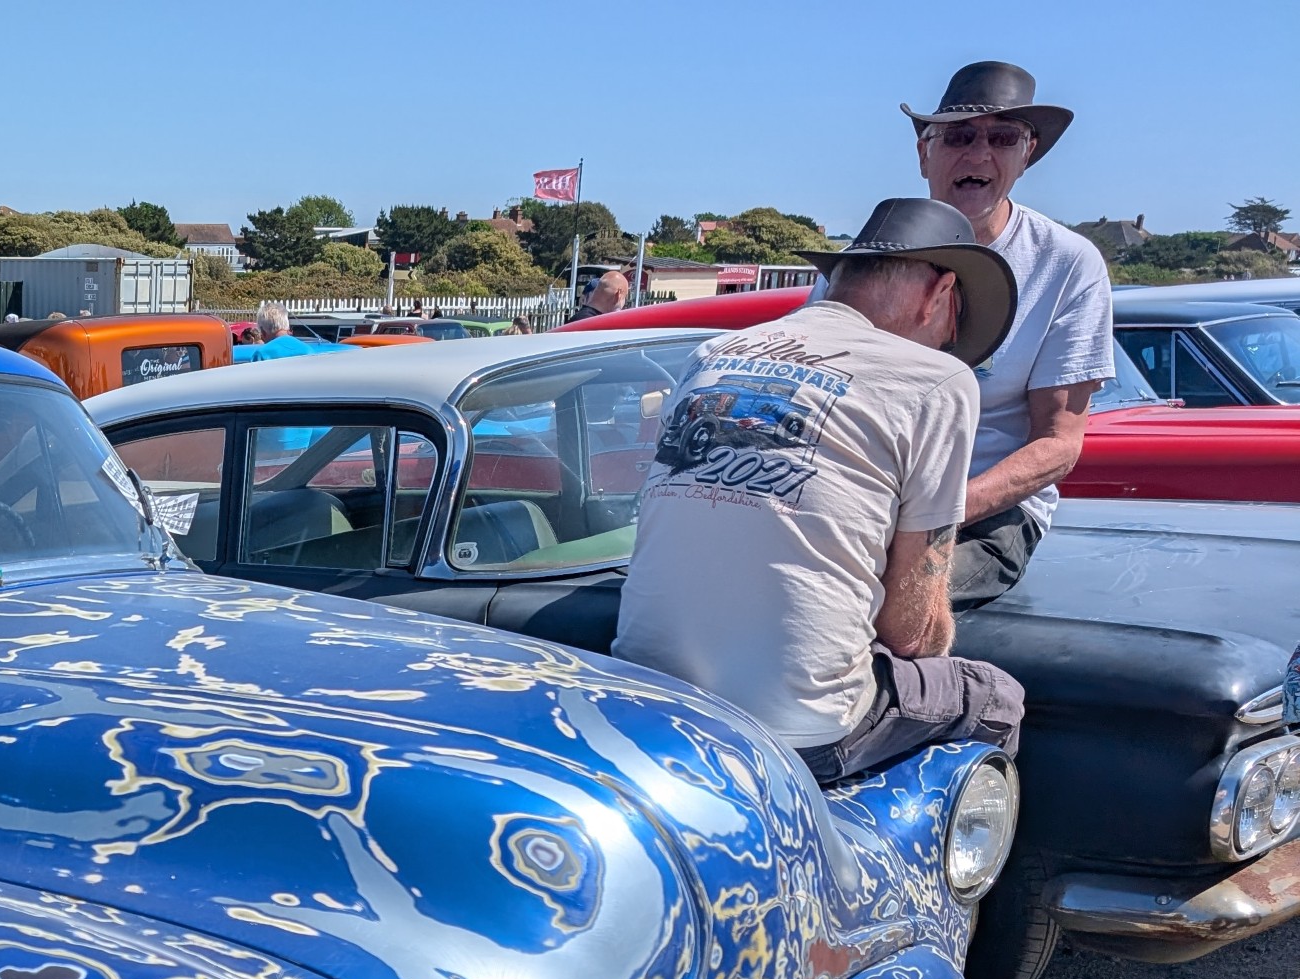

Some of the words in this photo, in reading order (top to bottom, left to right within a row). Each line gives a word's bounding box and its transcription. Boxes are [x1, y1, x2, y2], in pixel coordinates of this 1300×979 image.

[749, 337, 851, 366] Rod
[140, 357, 183, 378] Original
[685, 484, 763, 511] Bedfordshire,
